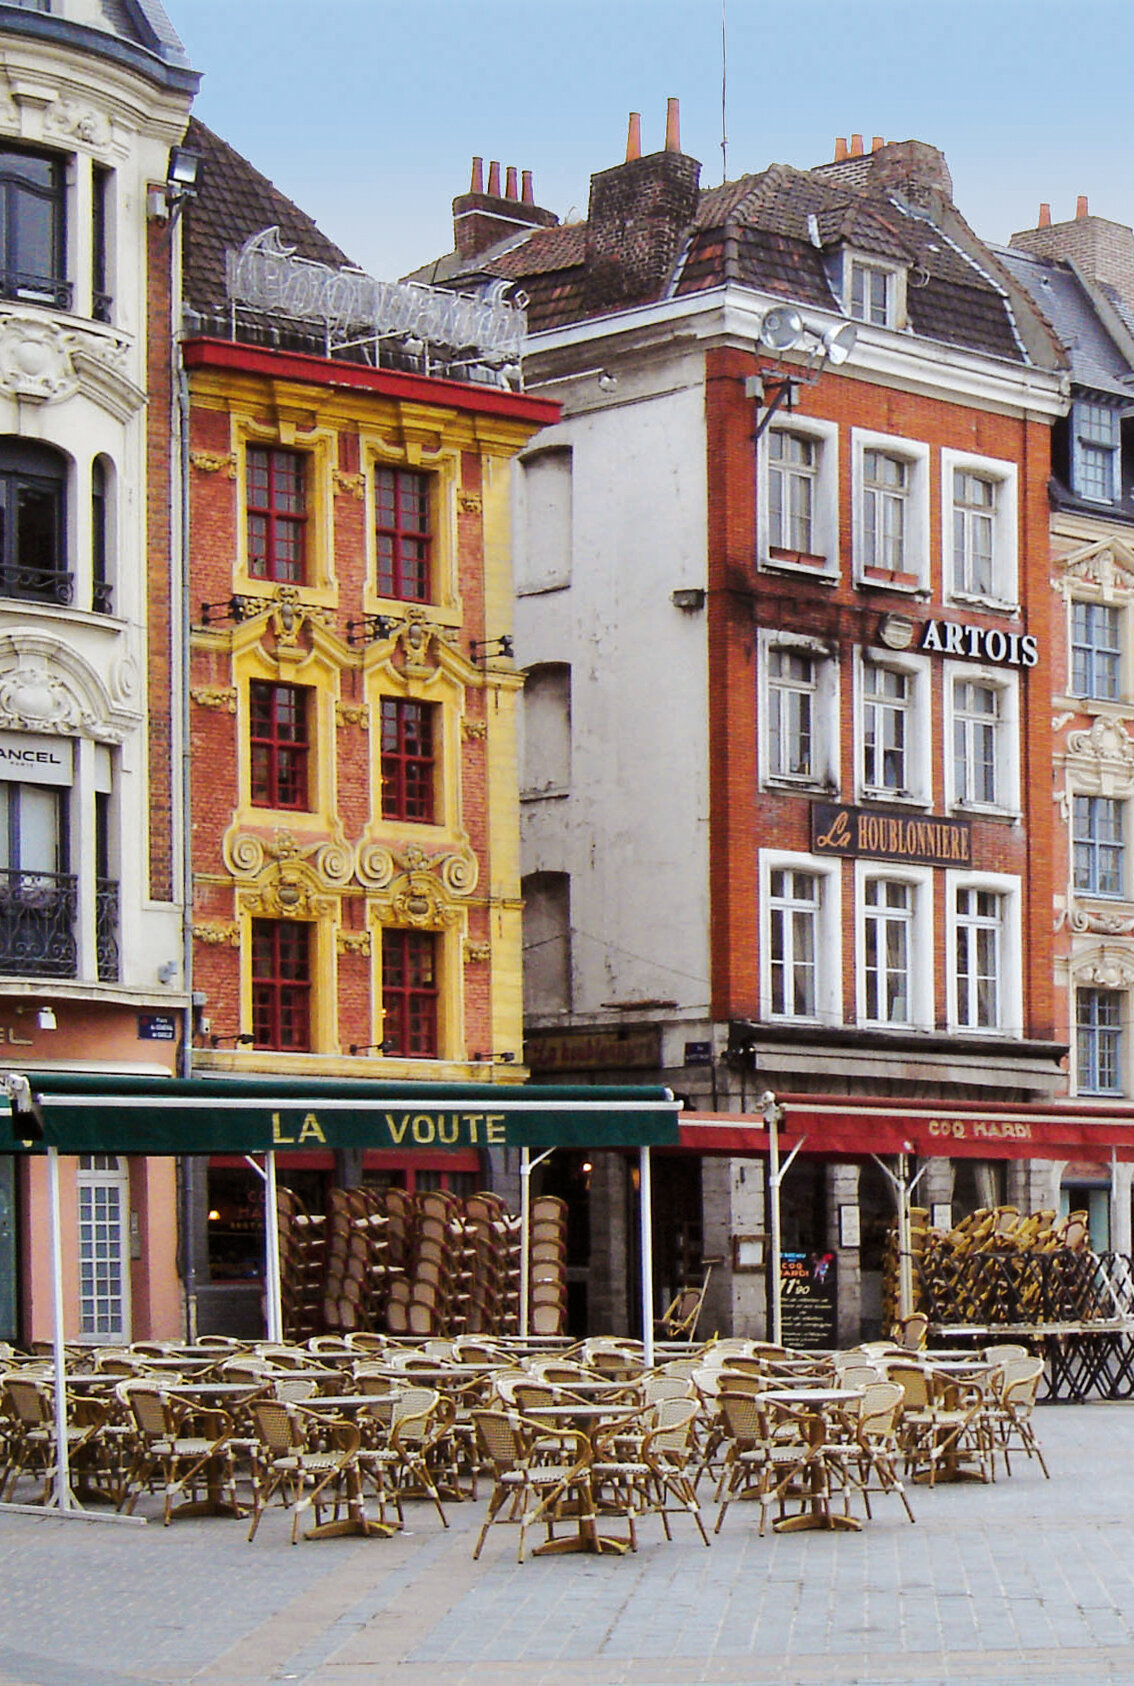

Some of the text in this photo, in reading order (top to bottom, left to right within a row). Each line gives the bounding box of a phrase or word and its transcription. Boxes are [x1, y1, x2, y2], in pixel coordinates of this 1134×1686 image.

[922, 619, 1039, 668] ARTOIS
[816, 810, 969, 861] La HOUBLONNIERE
[271, 1112, 506, 1144] LA VOUTE
[928, 1120, 1032, 1139] COQ HARDI
